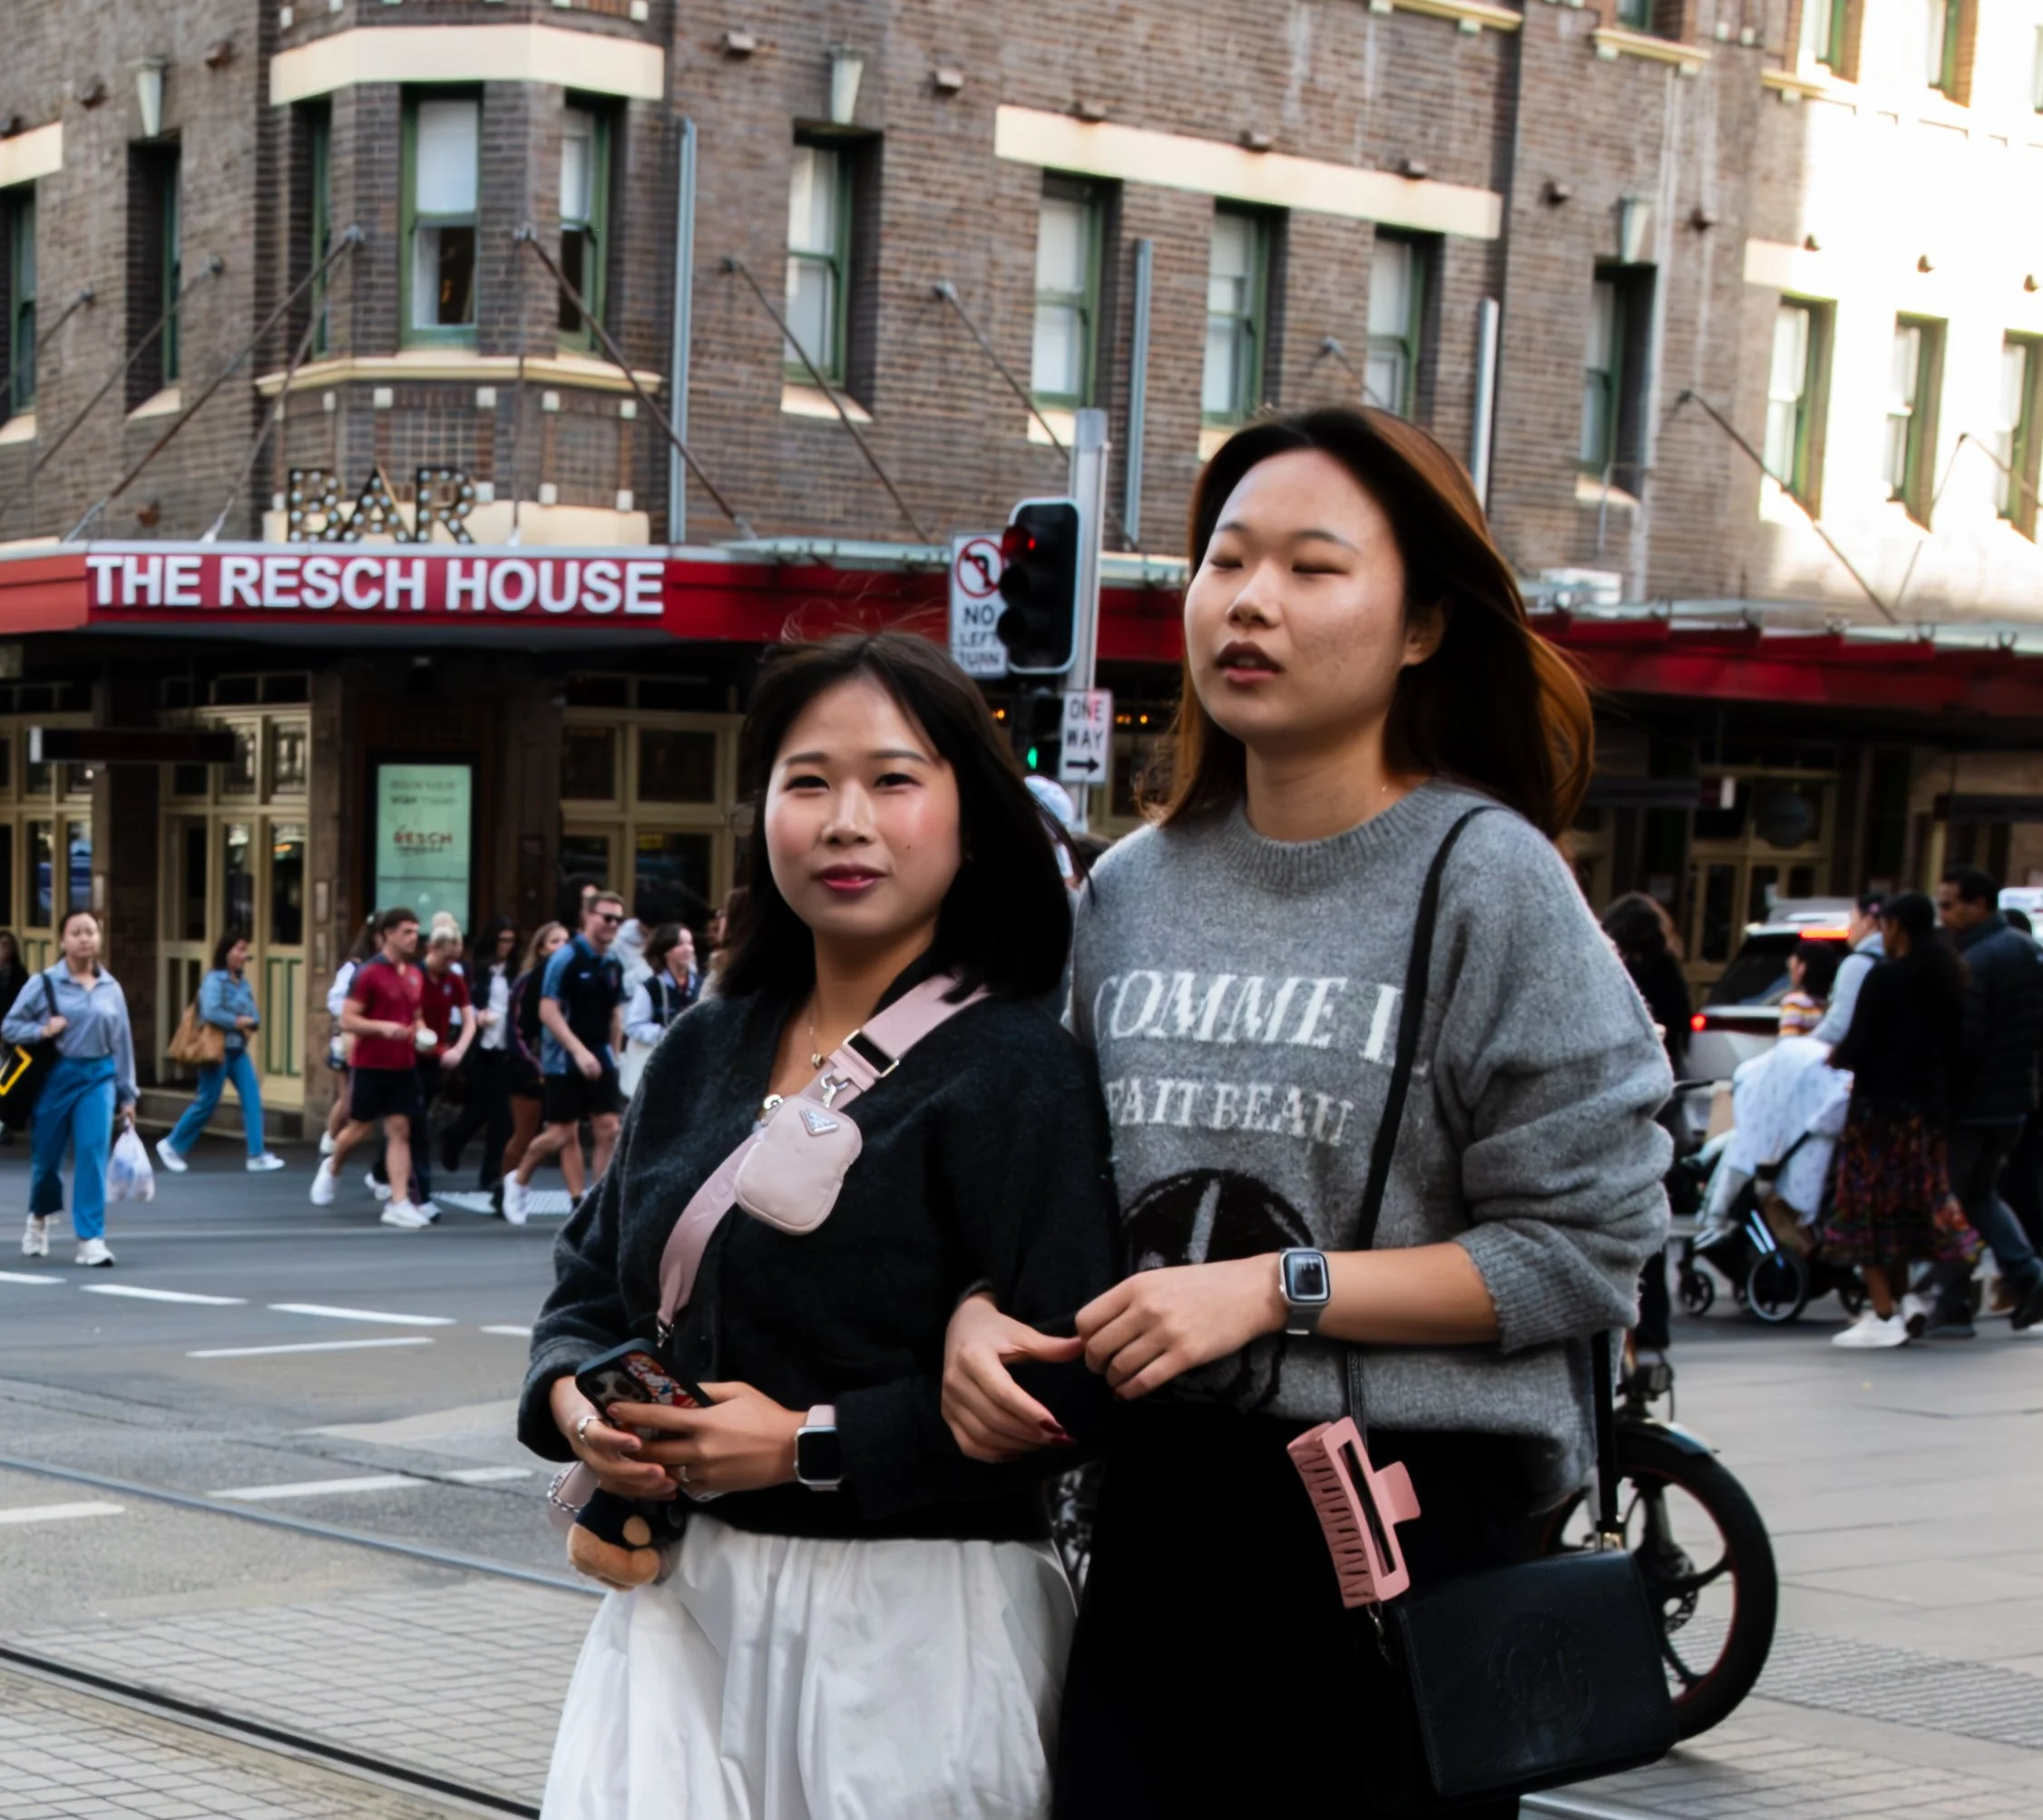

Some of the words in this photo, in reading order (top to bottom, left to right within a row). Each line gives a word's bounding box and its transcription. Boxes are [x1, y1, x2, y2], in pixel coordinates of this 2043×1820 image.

[287, 467, 475, 544] BAR
[86, 555, 202, 606] THE
[220, 557, 426, 611] RESCH
[446, 559, 664, 614] HOUSE
[963, 604, 995, 625] NO
[1069, 698, 1104, 721] ONE
[1066, 729, 1104, 750] WAY
[1208, 1081, 1354, 1147] BEAU
